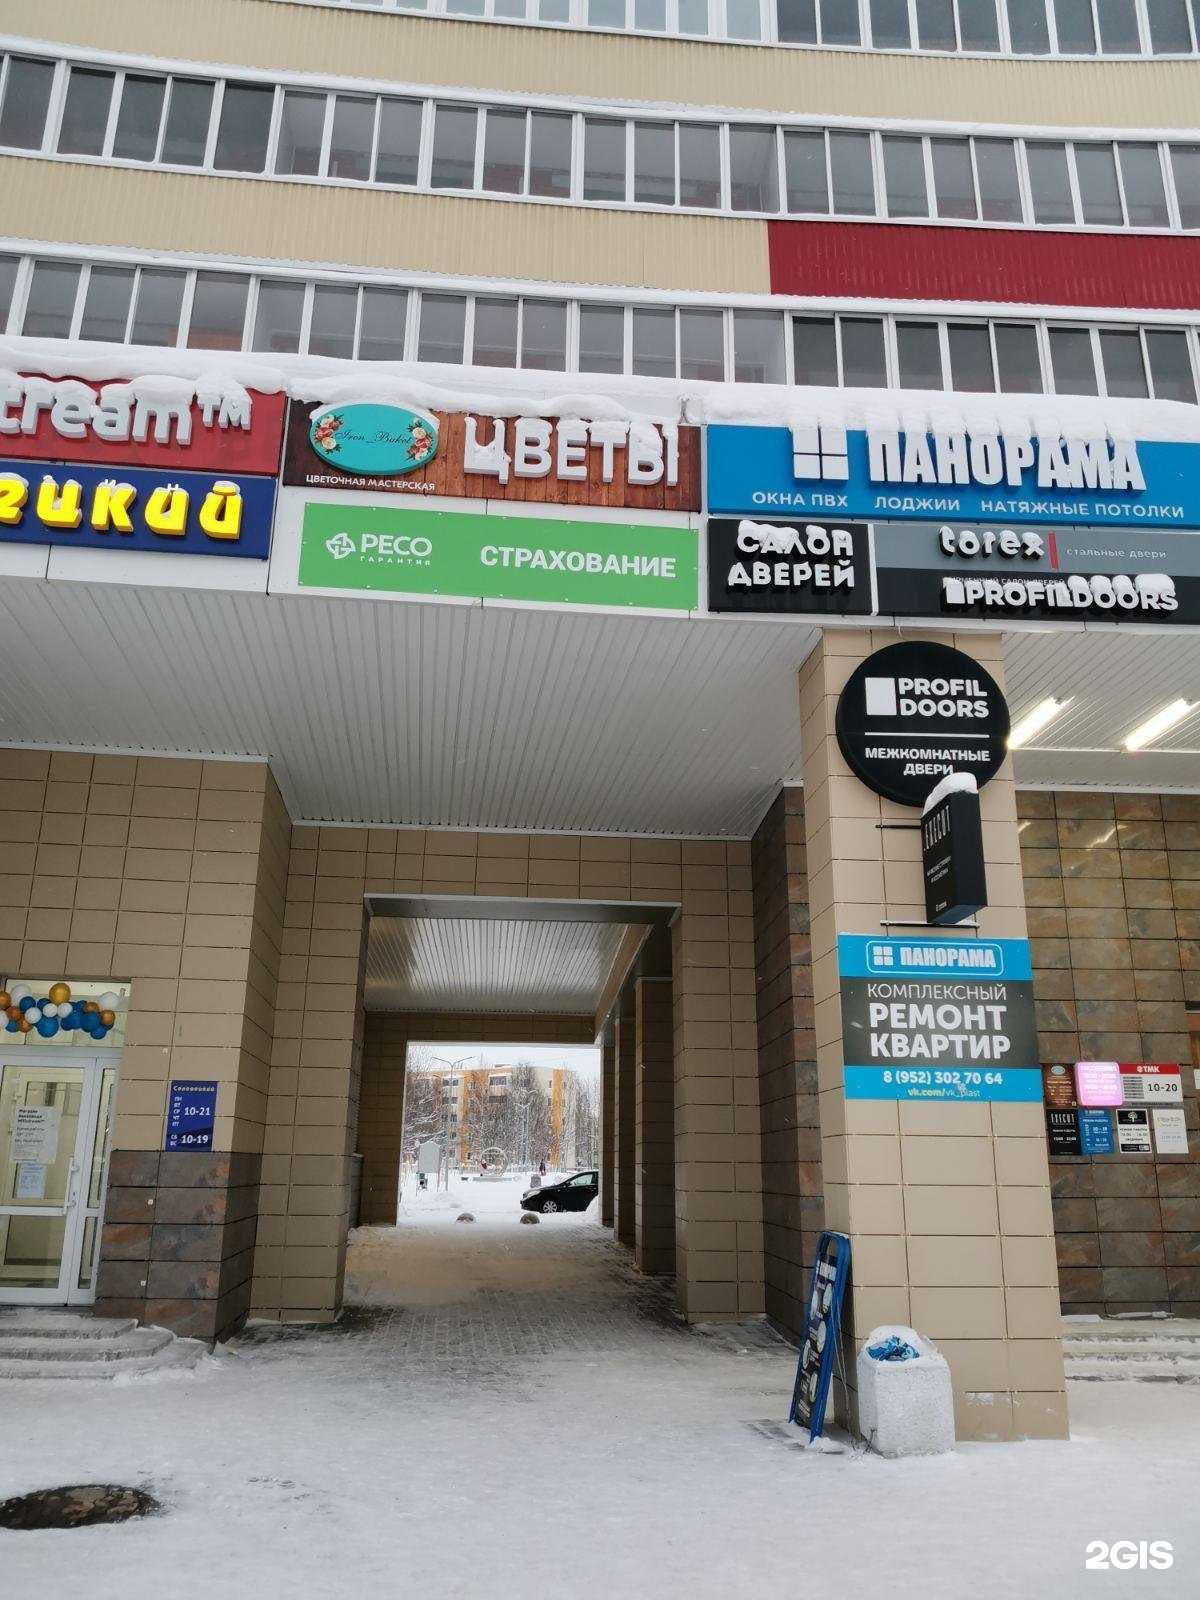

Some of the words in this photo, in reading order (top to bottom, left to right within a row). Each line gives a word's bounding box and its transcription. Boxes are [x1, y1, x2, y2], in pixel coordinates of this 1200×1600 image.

[463, 415, 680, 486] ЦВЕТЫ
[866, 427, 1148, 491] ПАНОРАМА
[305, 474, 366, 487] ЦВЕТОЧНАЯ
[367, 478, 436, 491] МАСТЕРСКАЯ
[752, 491, 805, 505] ОКНА
[811, 494, 848, 508] ПВХ
[874, 496, 960, 512] ЛОДЖИИ
[981, 500, 1090, 516] НАТЯЖНЫЕ
[1095, 503, 1185, 519] ПОТОЛКИ
[361, 533, 433, 557] РЕСО
[737, 522, 854, 556] САЛОН
[939, 525, 1045, 556] torex
[360, 556, 431, 566] ГАРАНТИЯ
[480, 544, 678, 579] СТРАХОВАНИЕ
[1066, 548, 1125, 558] стальные
[1129, 549, 1169, 559] двери
[727, 559, 855, 588] ДВЕРЕЙ
[964, 574, 1179, 611] PROFILDOORS
[898, 677, 988, 697] PROFIL
[900, 699, 989, 718] DOORS
[865, 747, 991, 762] МЕЖКОМНАТНЫЕ
[903, 763, 954, 776] ДВЕРИ
[900, 946, 997, 968] ПАНОРАМА
[867, 983, 1007, 1001] КОМПЛЕКСНЫЙ
[869, 1002, 1008, 1031] РЕМОНТ
[870, 1033, 1012, 1060] КВАРТИР
[883, 1070, 893, 1083] 8
[896, 1070, 931, 1085] (952)
[934, 1071, 962, 1084] 302
[964, 1072, 981, 1084] 70
[985, 1073, 1003, 1085] 64
[1148, 1083, 1178, 1092] 10-20
[184, 1107, 211, 1116] 10-21
[181, 1135, 209, 1144] 10-19
